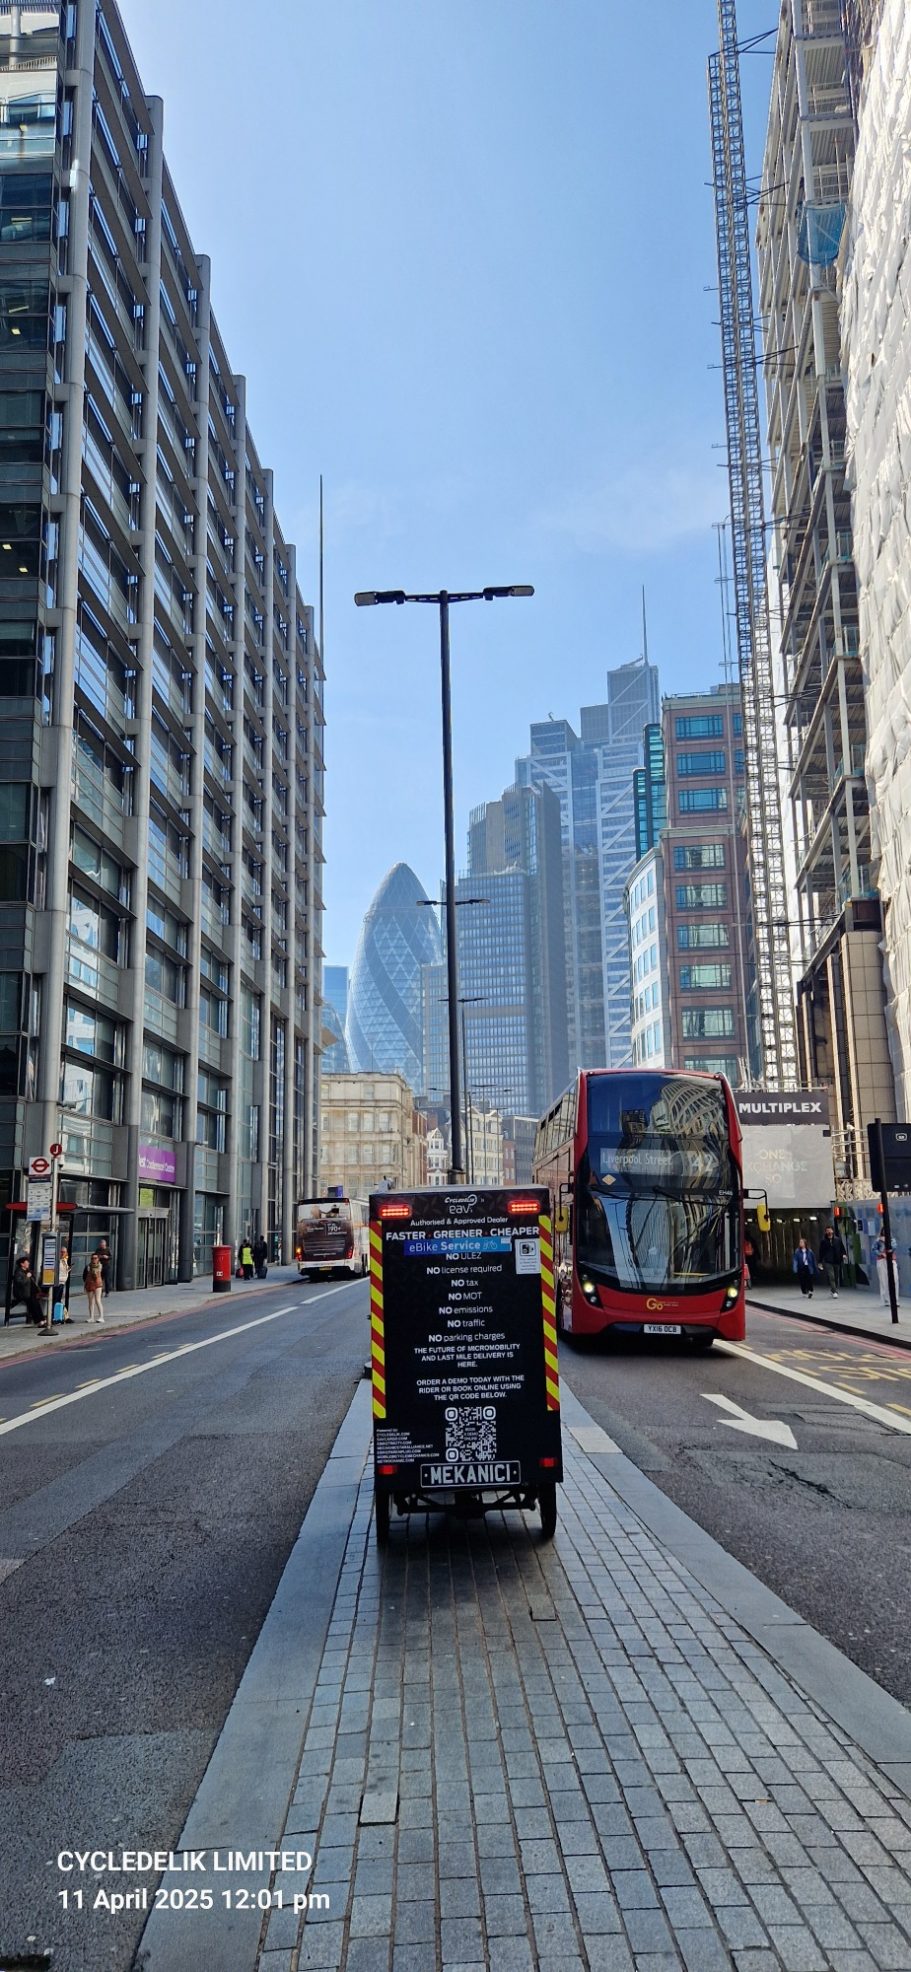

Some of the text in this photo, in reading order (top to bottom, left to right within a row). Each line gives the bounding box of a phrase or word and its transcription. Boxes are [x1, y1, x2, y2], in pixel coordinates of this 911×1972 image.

[738, 1102, 822, 1113] MULTIPLEX
[53, 1145, 59, 1154] J
[602, 1153, 642, 1166] Liverpool
[410, 1218, 445, 1227] Authorised
[453, 1217, 485, 1226] Approved
[486, 1216, 508, 1224] Dealer
[386, 1226, 540, 1241] FASTER GREENER CHEAPER
[409, 1240, 481, 1253] eBike Service
[460, 1252, 482, 1260] ULEZ
[426, 1264, 503, 1275] NO license required
[451, 1279, 478, 1287] NO tax
[448, 1292, 482, 1301] NO MOT
[646, 1297, 663, 1311] Go
[438, 1305, 493, 1315] NO emissions
[447, 1319, 485, 1328] NO traffic
[428, 1332, 505, 1343] NO parking charges
[467, 1344, 521, 1352] MICROMOBILITY
[473, 1352, 506, 1360] DELIVERY
[448, 1377, 468, 1385] DEMO
[469, 1376, 492, 1384] TODAY
[493, 1375, 510, 1383] WITH
[452, 1385, 473, 1393] BOOK
[473, 1384, 499, 1392] ONLINE
[431, 1463, 511, 1485] MEKANICI
